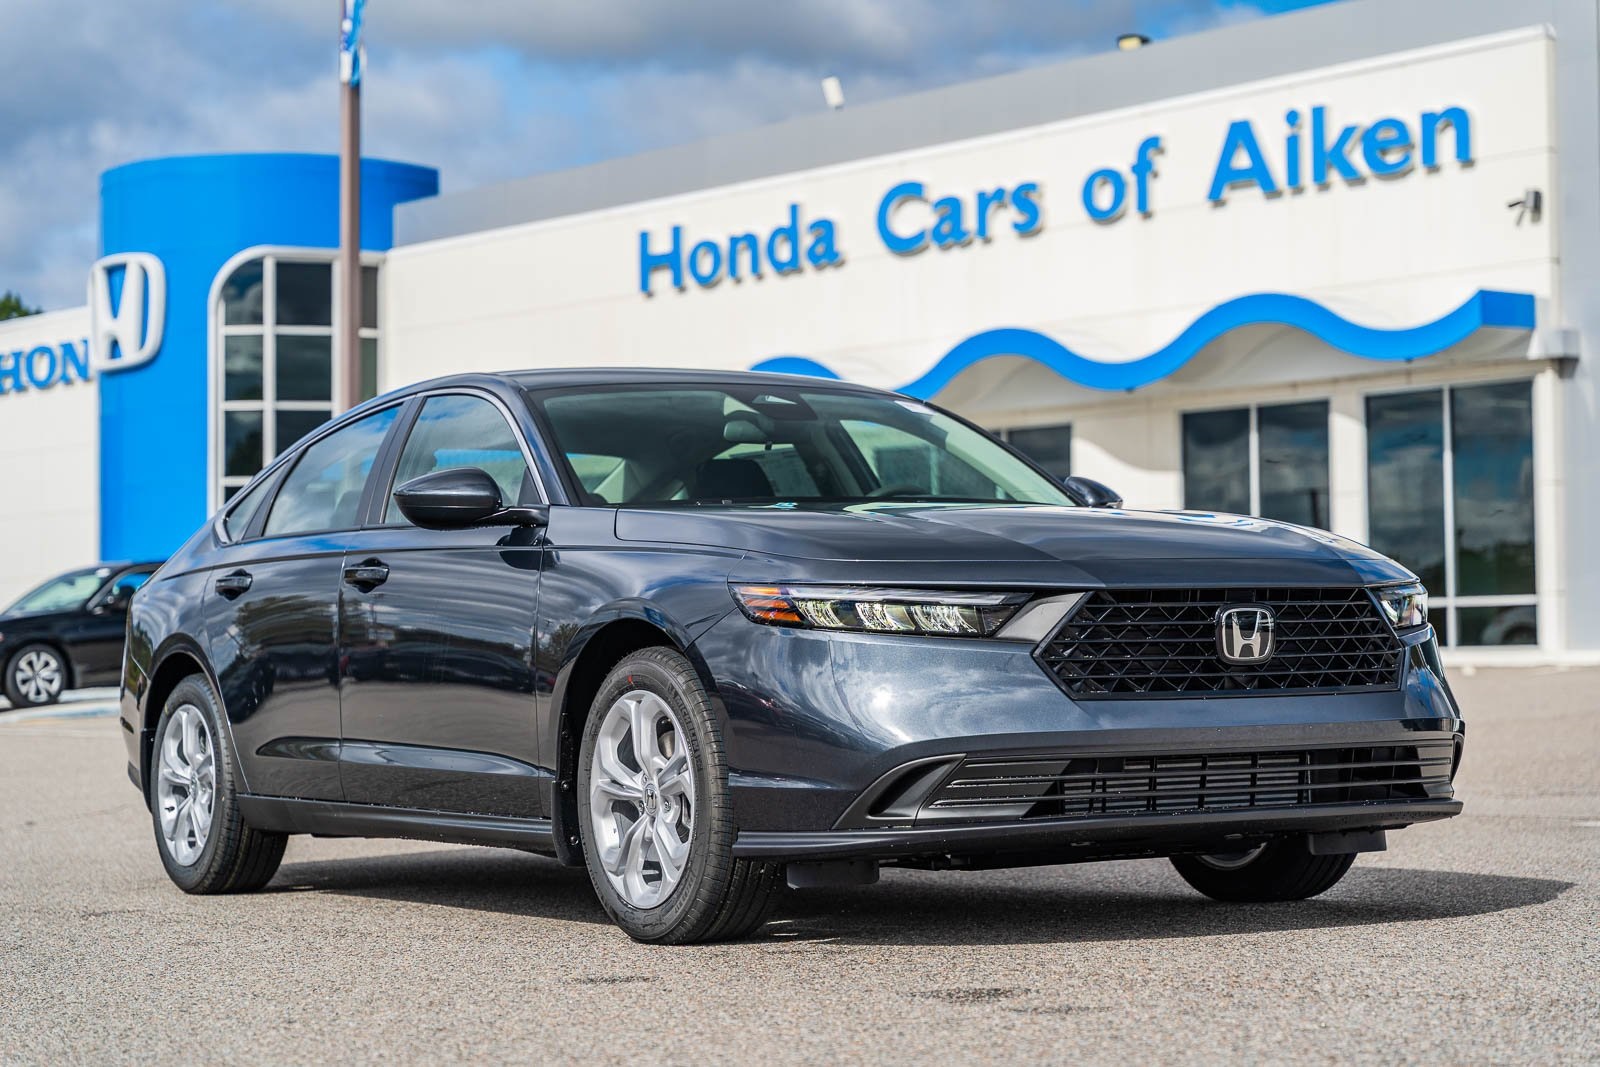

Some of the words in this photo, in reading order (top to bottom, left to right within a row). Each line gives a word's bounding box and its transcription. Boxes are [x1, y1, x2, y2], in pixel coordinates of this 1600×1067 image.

[639, 204, 842, 295] Honda
[876, 181, 1041, 255] Cars
[1082, 136, 1162, 220] of
[1208, 106, 1473, 204] Aiken
